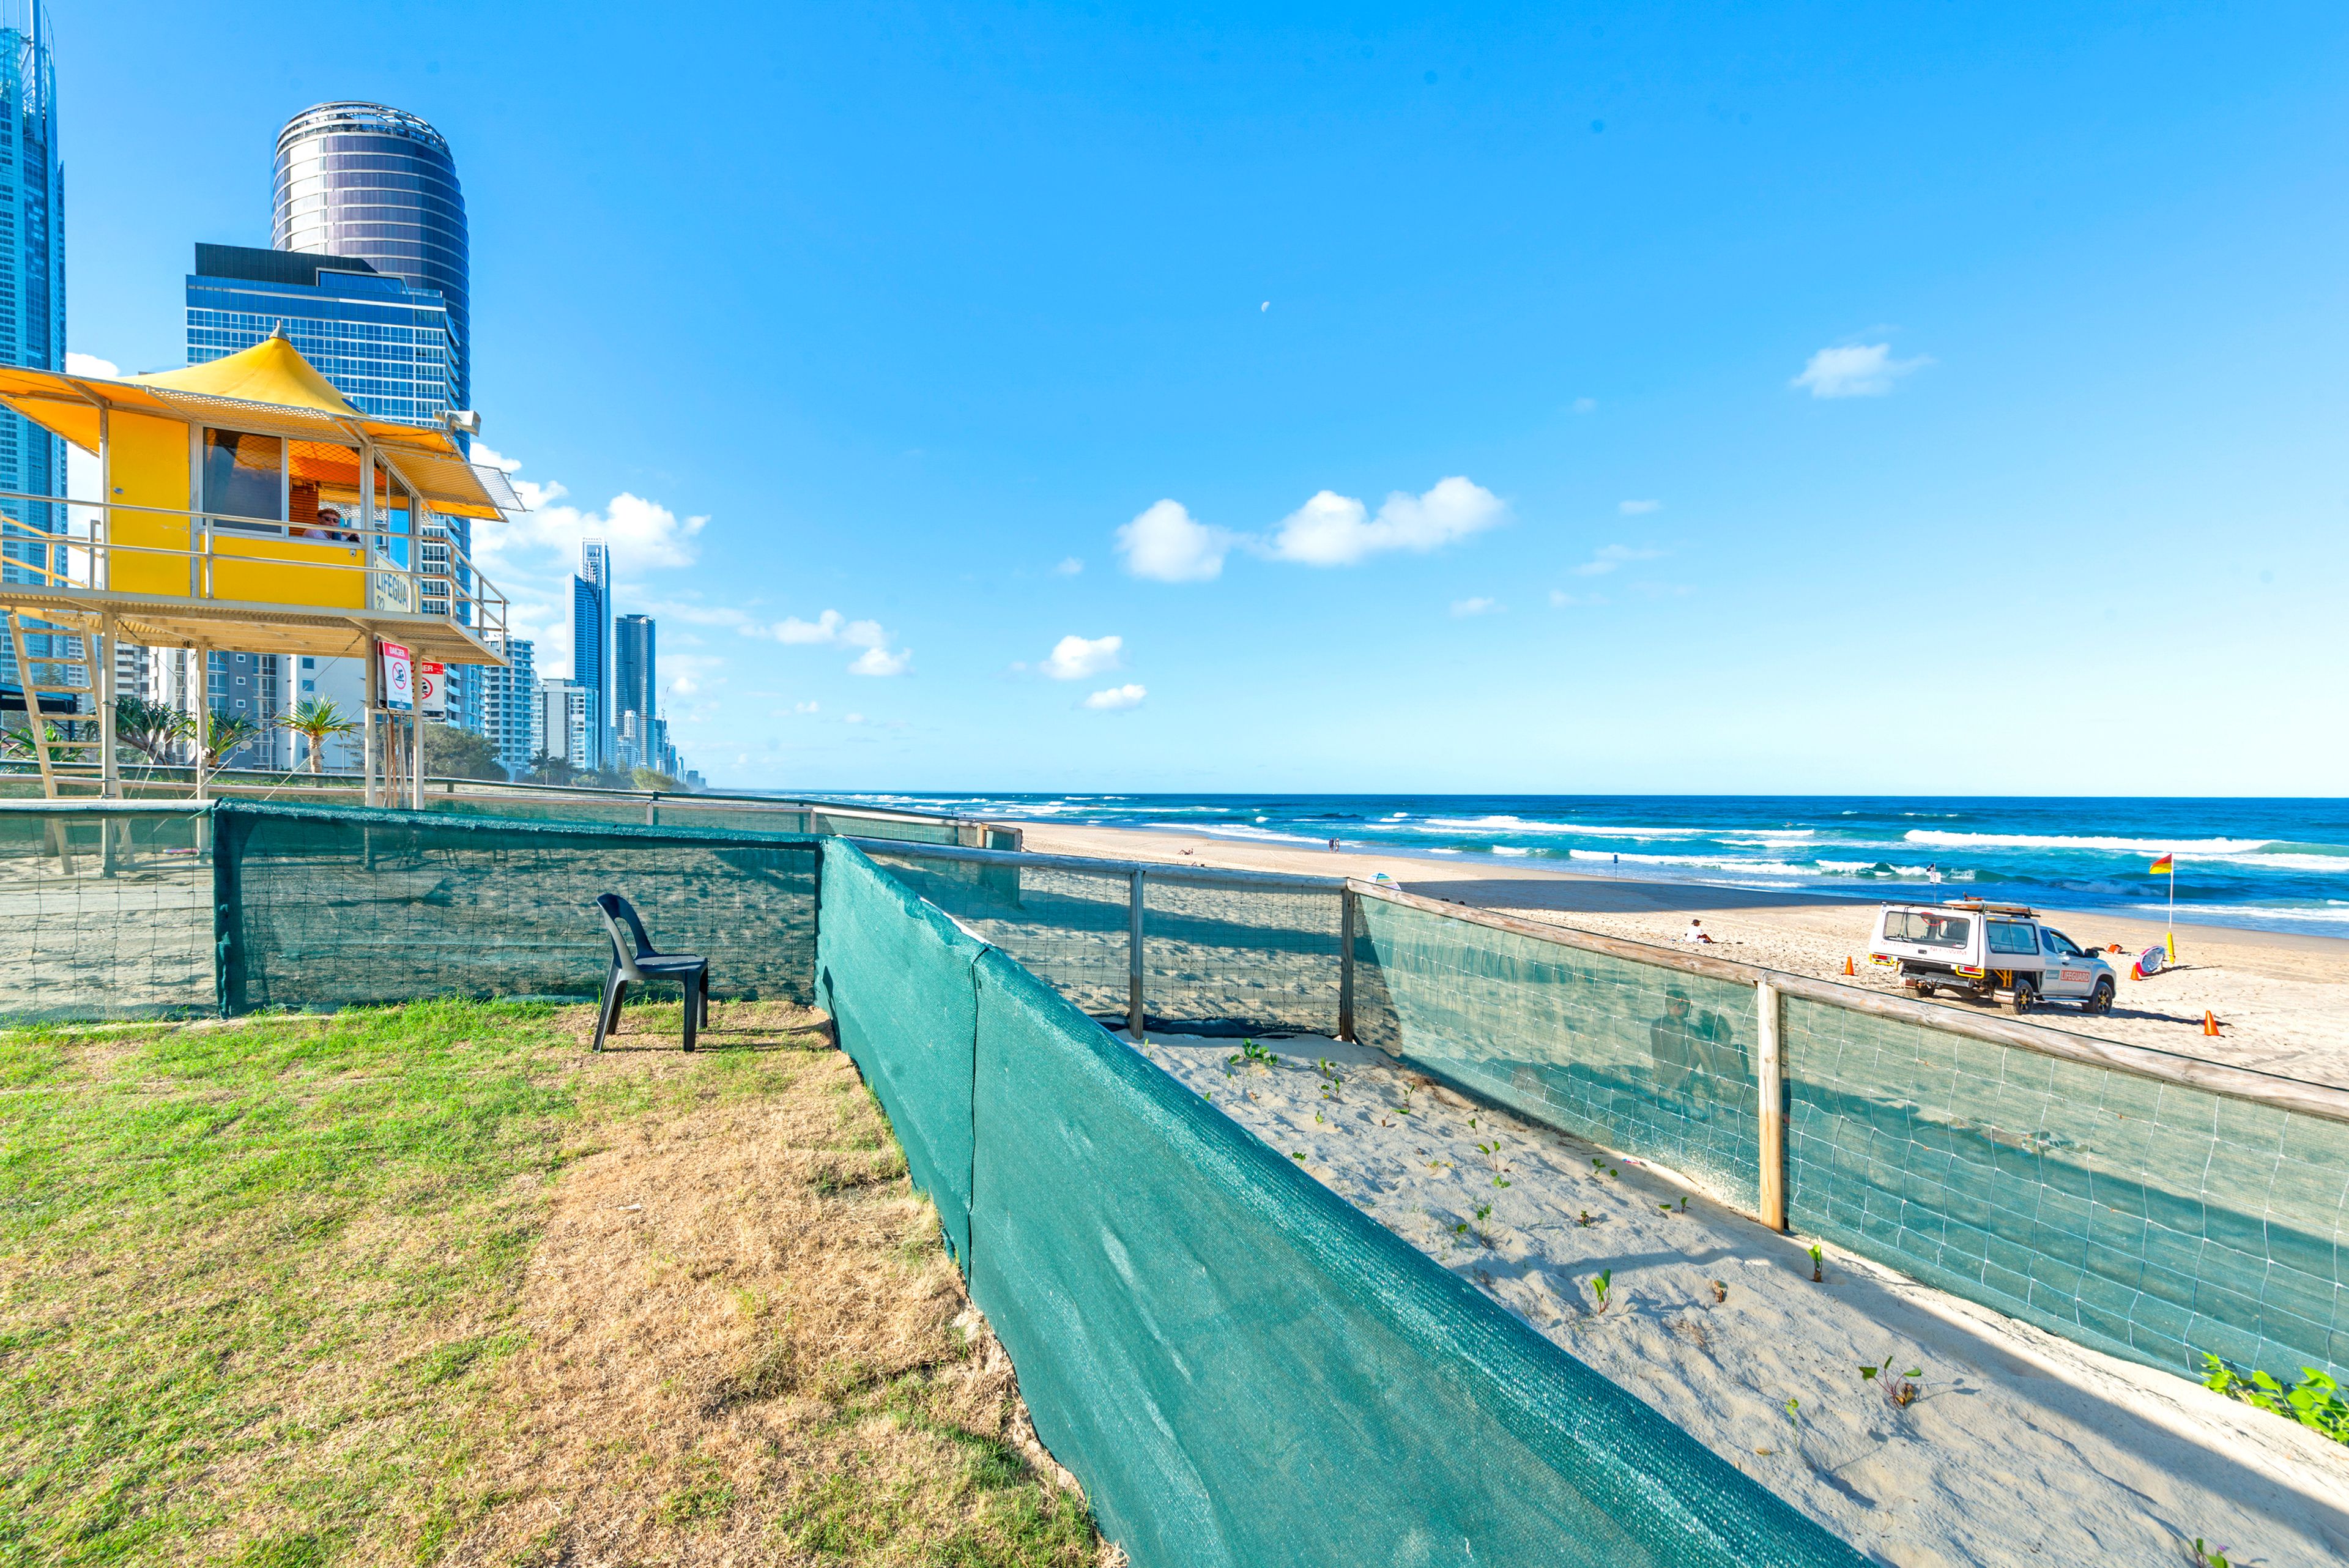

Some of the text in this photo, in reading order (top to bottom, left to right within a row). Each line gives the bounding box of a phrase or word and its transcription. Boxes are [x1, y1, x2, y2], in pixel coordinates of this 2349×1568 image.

[376, 563, 409, 609] LIFEGUA
[389, 646, 406, 657] DANGER
[2061, 971, 2090, 981] LIFEGUARD
